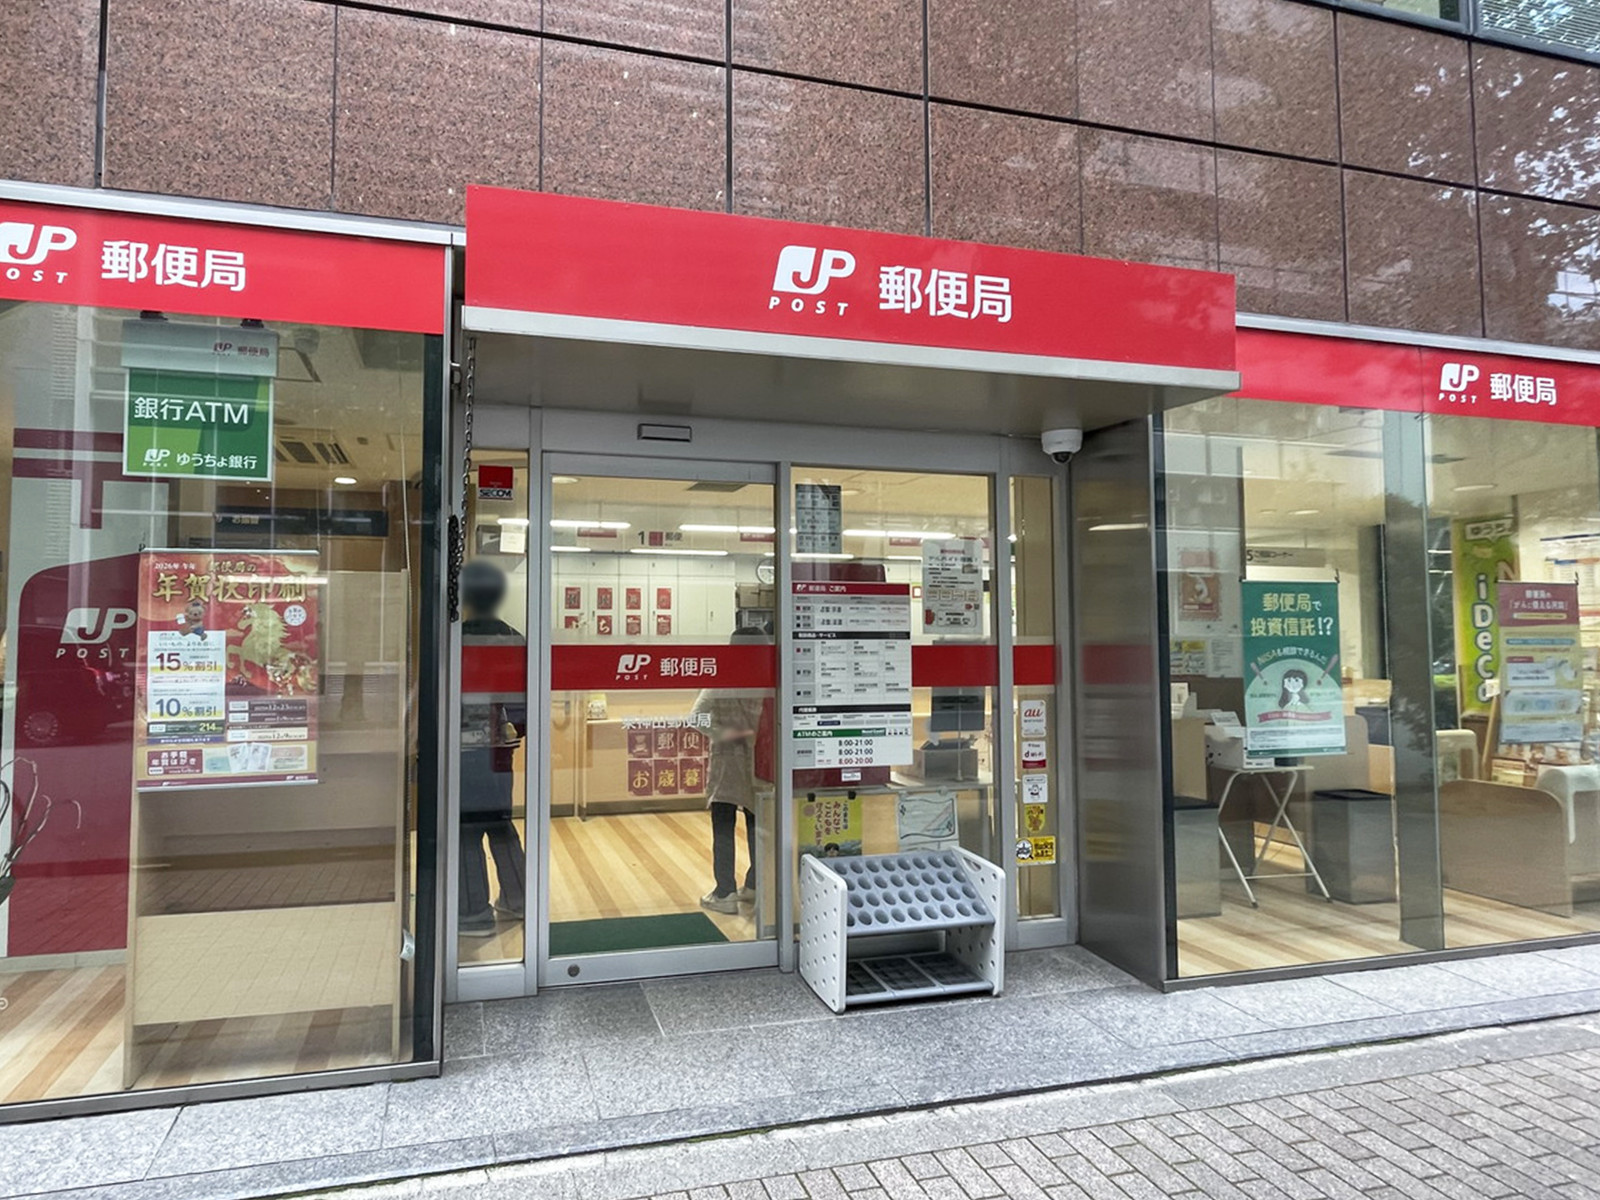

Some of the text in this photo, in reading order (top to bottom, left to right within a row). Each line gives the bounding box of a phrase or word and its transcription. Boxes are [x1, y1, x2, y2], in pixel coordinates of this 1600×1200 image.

[5, 266, 69, 284] OST
[101, 239, 247, 292] 郵便局
[772, 245, 1013, 323] JP 郵便局
[768, 296, 849, 316] POST
[1440, 362, 1557, 406] JP 郵便局
[1438, 393, 1477, 404] POST
[133, 396, 249, 425] 銀行ATM
[177, 452, 258, 470] ゆうちょ銀行
[479, 488, 512, 498] SECOM
[637, 530, 645, 546] 1
[153, 572, 309, 603] 年賀状印刷
[1263, 593, 1322, 613] 郵便局で
[60, 607, 137, 644] JP
[1250, 616, 1334, 637] 投資信託!?
[56, 648, 129, 659] POST
[156, 652, 218, 672] 15%割引
[617, 654, 718, 677] JP 郵便局
[615, 674, 648, 682] POST
[155, 698, 218, 718] 10%割引
[1024, 708, 1043, 718] au
[657, 732, 701, 751] 郵便
[797, 730, 833, 738] ATMのご案内
[633, 768, 701, 789] お歳暮
[833, 801, 841, 835] みんなで
